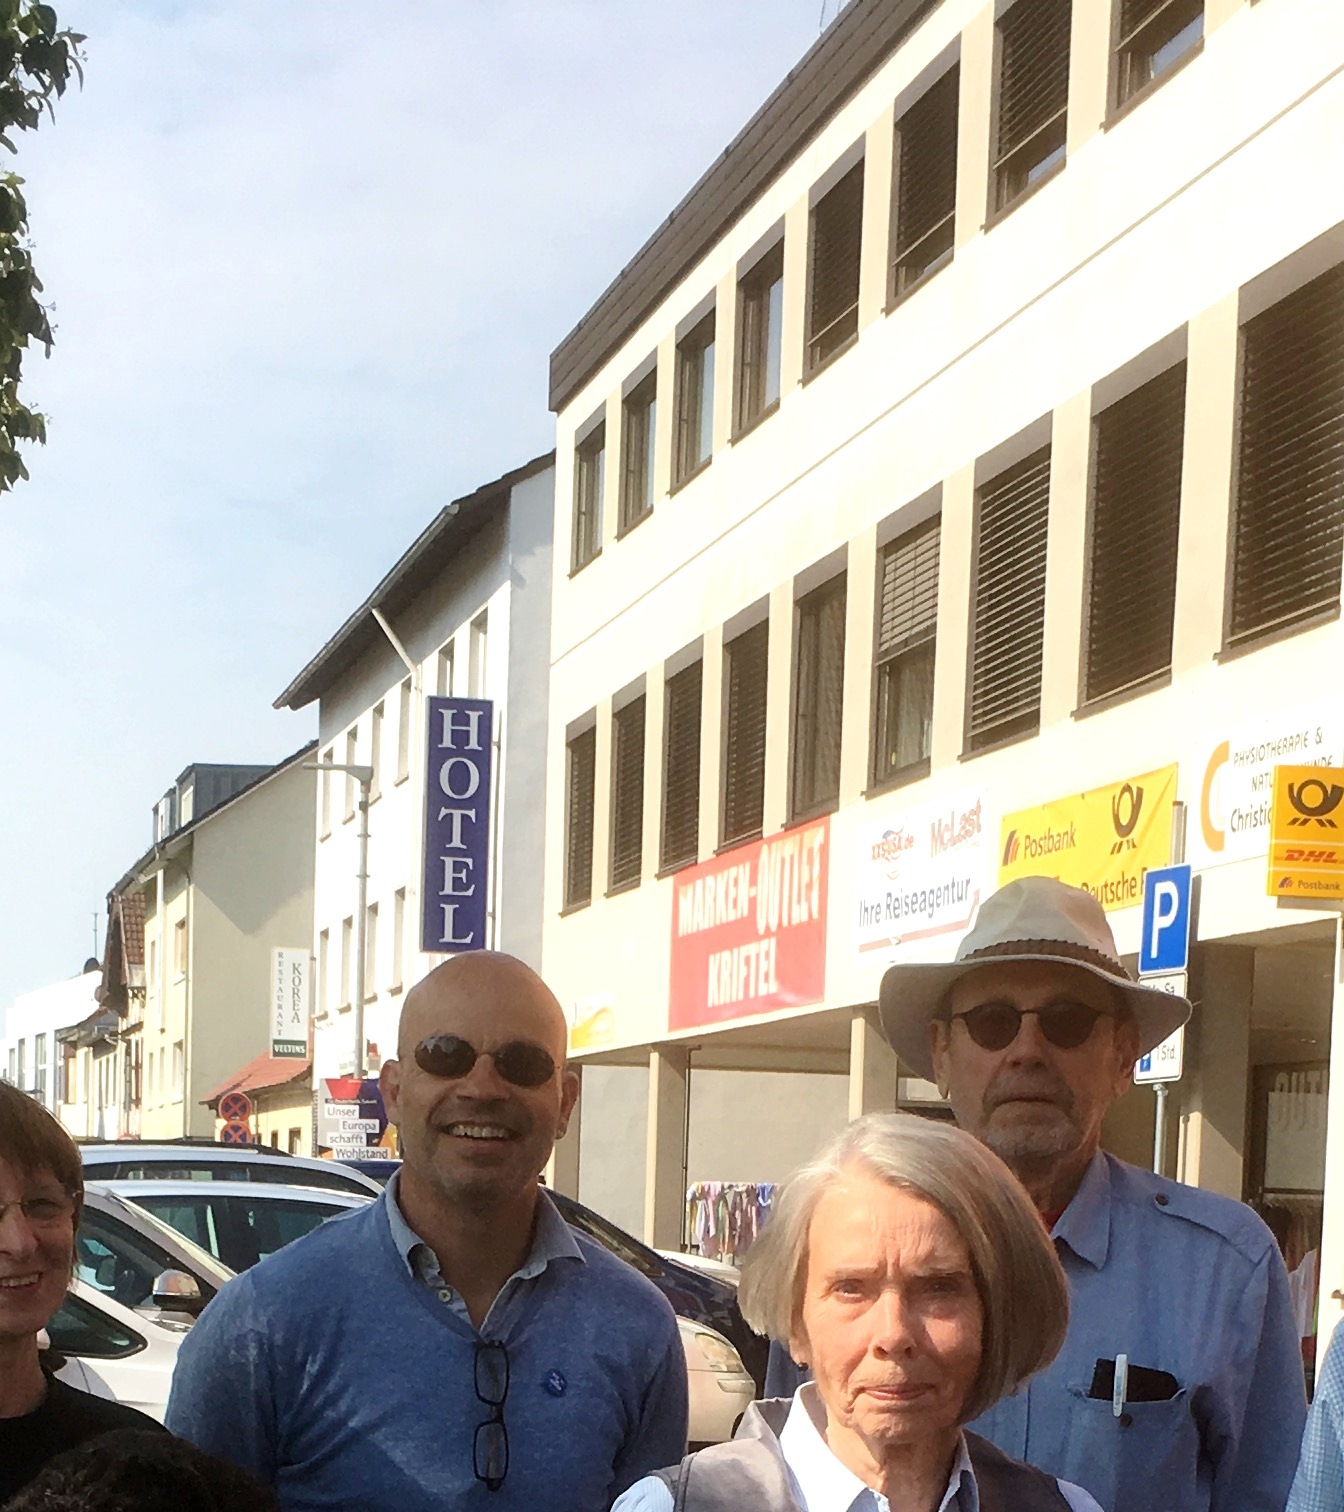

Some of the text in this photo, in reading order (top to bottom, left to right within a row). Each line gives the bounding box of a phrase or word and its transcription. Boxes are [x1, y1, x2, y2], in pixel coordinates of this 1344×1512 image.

[1233, 730, 1309, 768] PHYSIOTHERAPIE
[437, 708, 484, 944] HOTEL
[1023, 821, 1077, 859] Postbank
[1284, 849, 1339, 864] DHL
[678, 825, 825, 937] MARKEN-OUTLET
[1298, 880, 1341, 891] Postbank
[859, 875, 971, 928] Ihre Reiseagentur
[1150, 880, 1179, 959] P
[707, 936, 778, 1008] KRIFTEL
[277, 951, 285, 1037] RESTAURANT
[291, 962, 303, 1024] KOREA
[273, 1044, 305, 1054] VELTINS
[327, 1104, 357, 1117] Unser
[342, 1120, 377, 1133] Europa
[329, 1133, 364, 1145] schafft
[335, 1148, 389, 1160] Wohlstand
